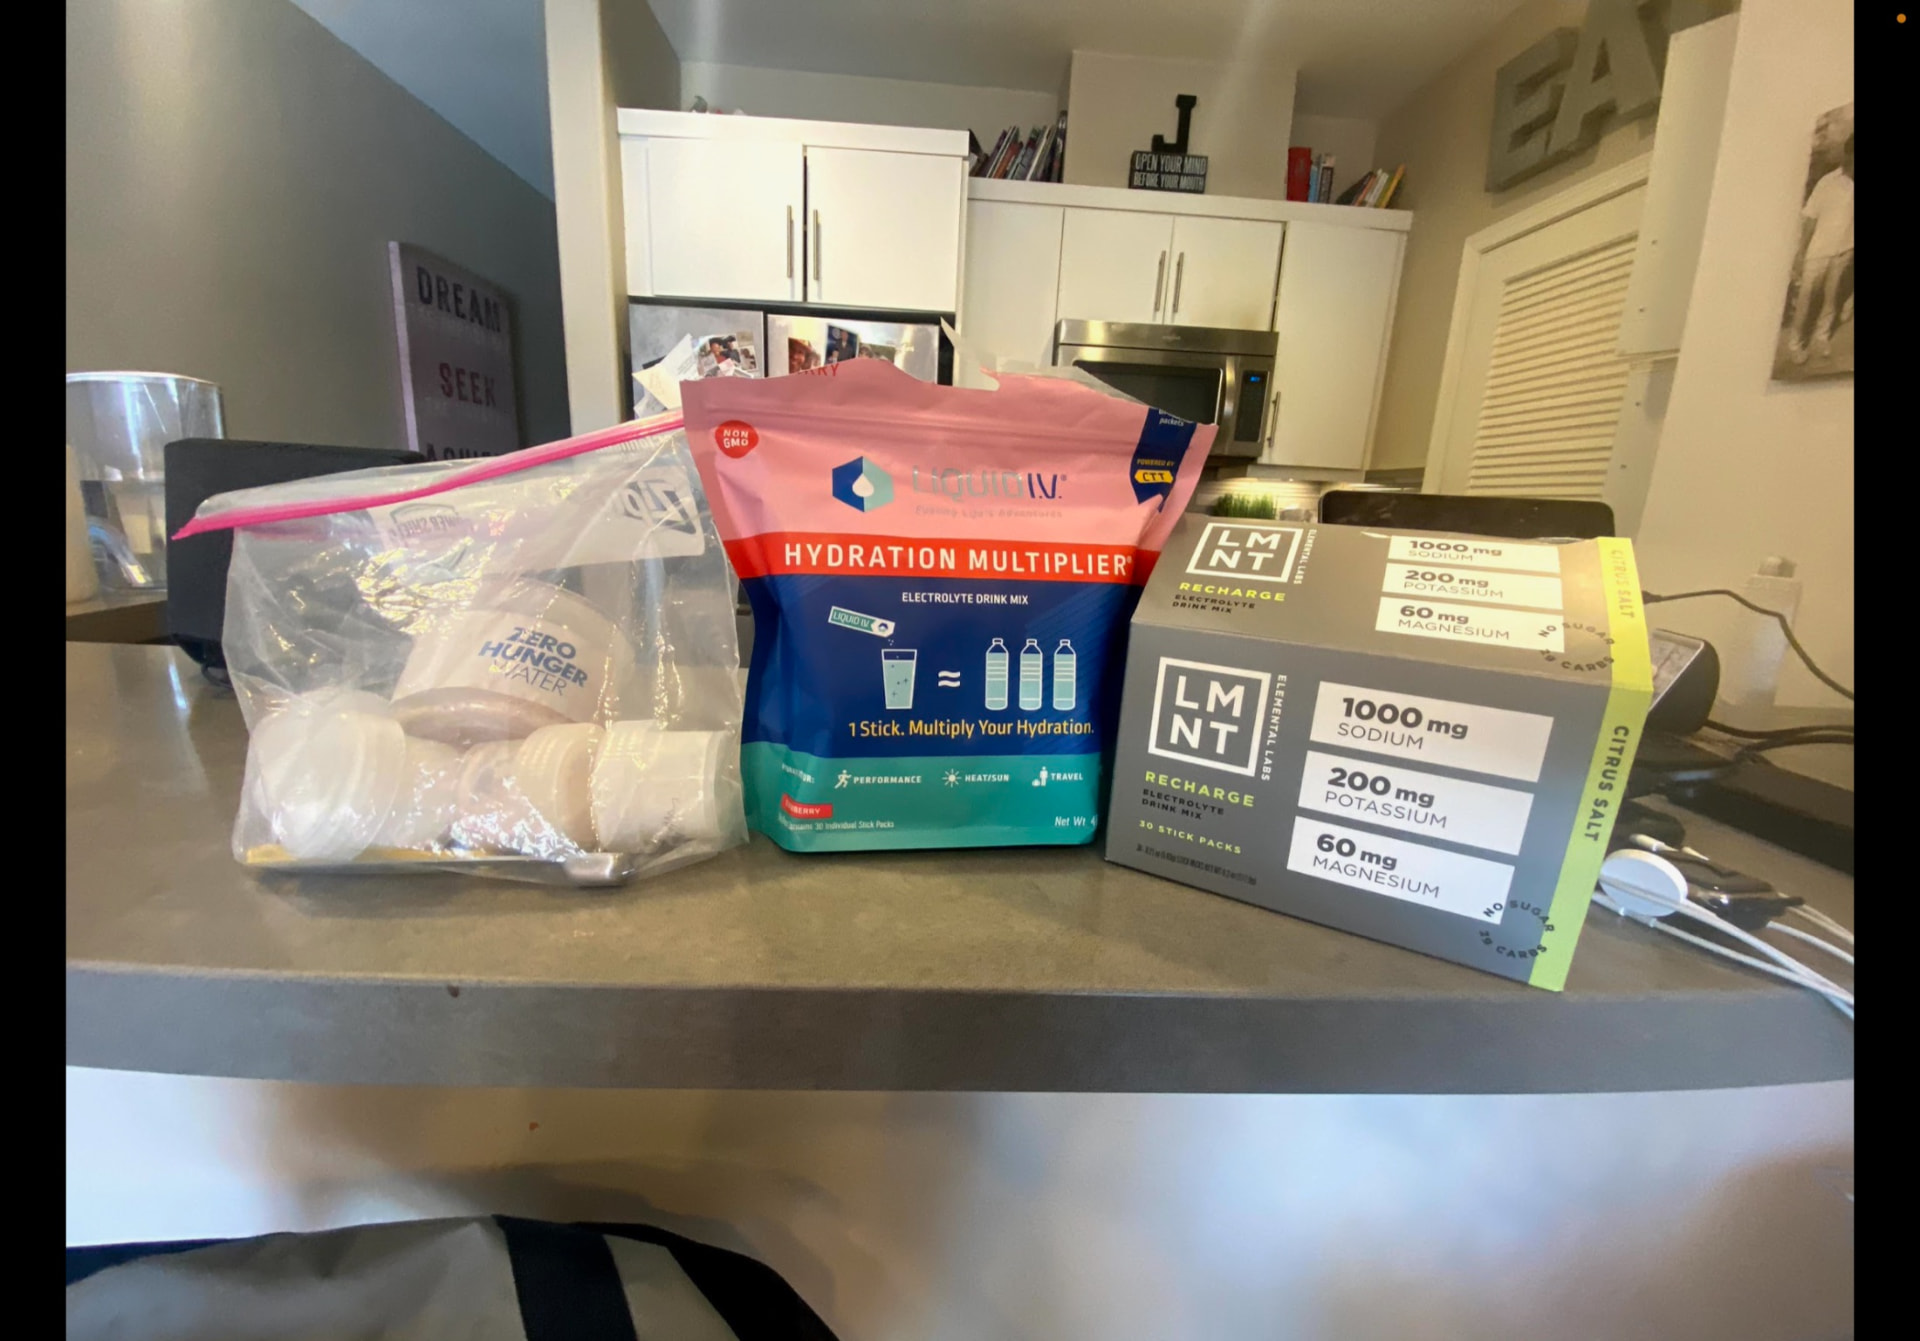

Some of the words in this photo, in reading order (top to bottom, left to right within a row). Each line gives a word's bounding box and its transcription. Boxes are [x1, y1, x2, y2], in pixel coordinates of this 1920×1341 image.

[1135, 153, 1159, 171] OPEN
[1160, 154, 1182, 173] YOUR
[1183, 157, 1207, 175] MIND
[1133, 171, 1159, 187] BEFORE
[1160, 173, 1179, 188] YOUR
[1180, 175, 1204, 191] MOUTH
[416, 265, 501, 333] DREAM
[439, 362, 497, 407] SEEK
[723, 429, 749, 439] NON
[723, 438, 749, 449] GMO
[912, 465, 1024, 503] LIQUID
[1142, 472, 1165, 481] CTT
[784, 543, 956, 570] HYDRATION
[1408, 549, 1473, 562] SODIUM
[1409, 540, 1469, 552] 1000
[1472, 546, 1503, 557] mg
[1405, 569, 1454, 584] 200
[1458, 577, 1489, 588] mg
[1611, 549, 1630, 586] CITRUS
[902, 592, 974, 604] ELECTROLYTE
[975, 593, 1008, 605] DRINK
[1010, 594, 1029, 605] MIX
[1174, 594, 1256, 609] ELECTROLYTE
[1179, 582, 1286, 602] RECHARGE
[1403, 581, 1504, 598] POTASSIUM
[1172, 601, 1207, 611] DRINK
[1211, 606, 1233, 614] MIX
[1400, 605, 1434, 619] 60
[1438, 612, 1469, 625] mg
[1617, 589, 1635, 619] SALT
[833, 611, 860, 625] LIQUID
[1398, 619, 1510, 641] MAGNESIUM
[1538, 625, 1557, 638] NO
[505, 626, 577, 660] ZERO
[478, 640, 589, 688] HUNGER
[1174, 674, 1246, 718] LM
[1266, 674, 1287, 746] ELEMENTAL
[1343, 697, 1423, 729] 1000
[1426, 717, 1469, 740] mg
[848, 721, 856, 737] 1
[860, 719, 905, 737] Stick.
[909, 719, 975, 739] Multiply
[979, 719, 1014, 735] Your
[1017, 718, 1094, 739] Hydration.
[1169, 713, 1239, 755] NT
[1337, 722, 1424, 750] SODIUM
[1261, 750, 1275, 781] LABS
[1598, 725, 1630, 791] CITRUS
[853, 775, 922, 785] PERFORMANCE
[964, 773, 1010, 783] HEAT/SUN
[1051, 772, 1084, 781] TRAVEL
[1145, 770, 1255, 807] RECHARGE
[1327, 766, 1391, 796] 200
[1395, 787, 1435, 809] mg
[1141, 798, 1177, 814] DRINK
[1181, 808, 1203, 820] MIX
[1142, 788, 1225, 816] ELECTROLYTE
[1325, 790, 1447, 828] POTASSIUM
[815, 822, 824, 831] 30
[825, 820, 857, 831] Individual
[858, 820, 874, 830] Stick
[876, 820, 895, 829] Packs
[1054, 815, 1070, 827] Net
[1073, 815, 1086, 827] Wt
[1584, 798, 1609, 842] SALT
[1139, 819, 1154, 830] 30
[1158, 825, 1194, 842] STICK
[1199, 836, 1242, 855] PACKS
[1316, 833, 1357, 858] 60
[1360, 849, 1398, 871] mg
[1313, 855, 1440, 899] MAGNESIUM
[1483, 902, 1504, 918] NO
[1509, 900, 1556, 932] SUGAR
[1496, 943, 1548, 959] CARBS
